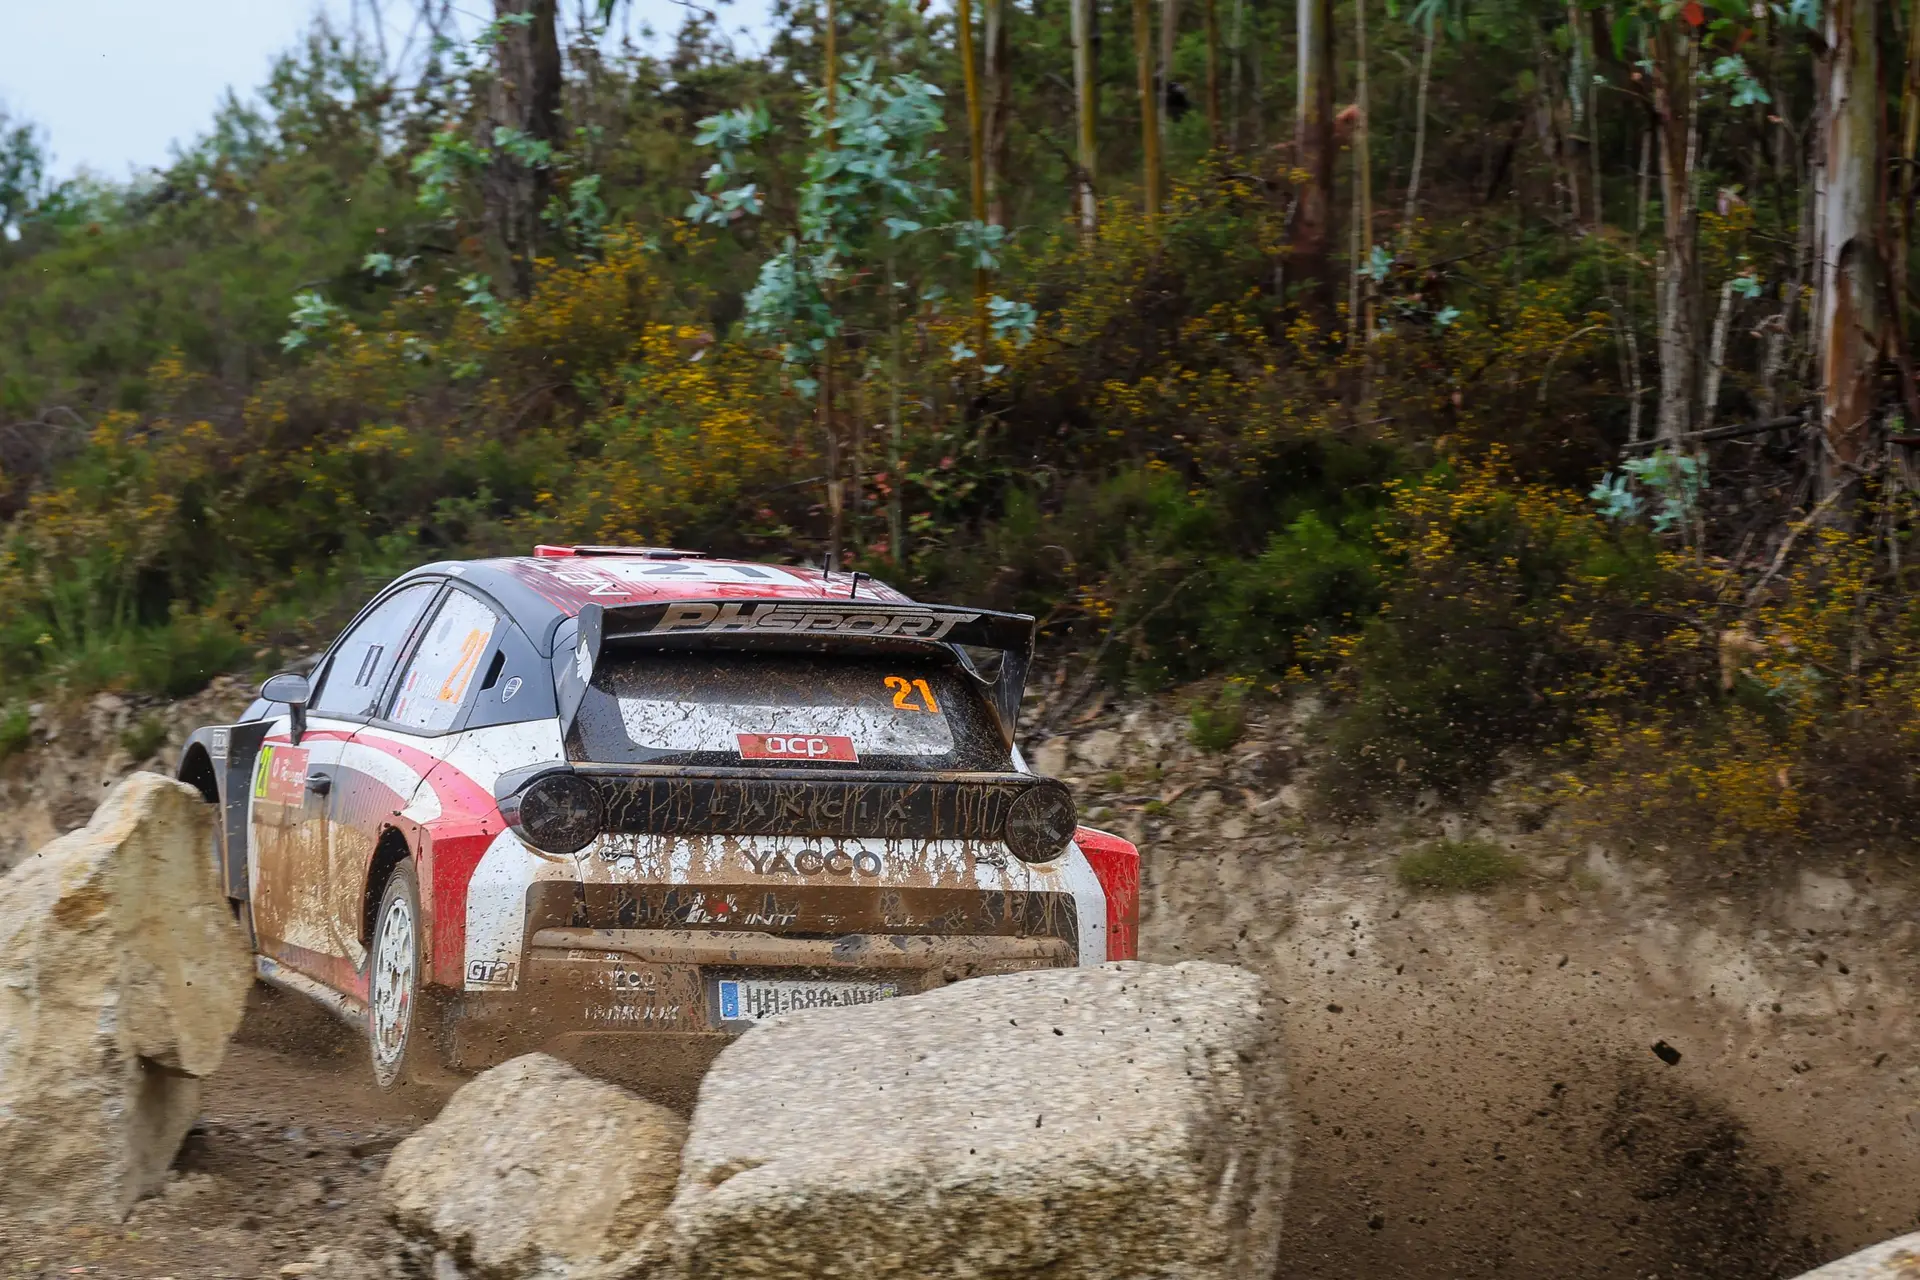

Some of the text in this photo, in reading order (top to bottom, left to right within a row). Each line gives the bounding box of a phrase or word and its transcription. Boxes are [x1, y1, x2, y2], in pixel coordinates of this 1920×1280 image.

[624, 562, 773, 579] 21
[436, 628, 490, 704] 21
[883, 676, 939, 713] 21
[765, 737, 829, 757] acp
[710, 795, 906, 819] LANCIA
[738, 849, 882, 877] YACCO
